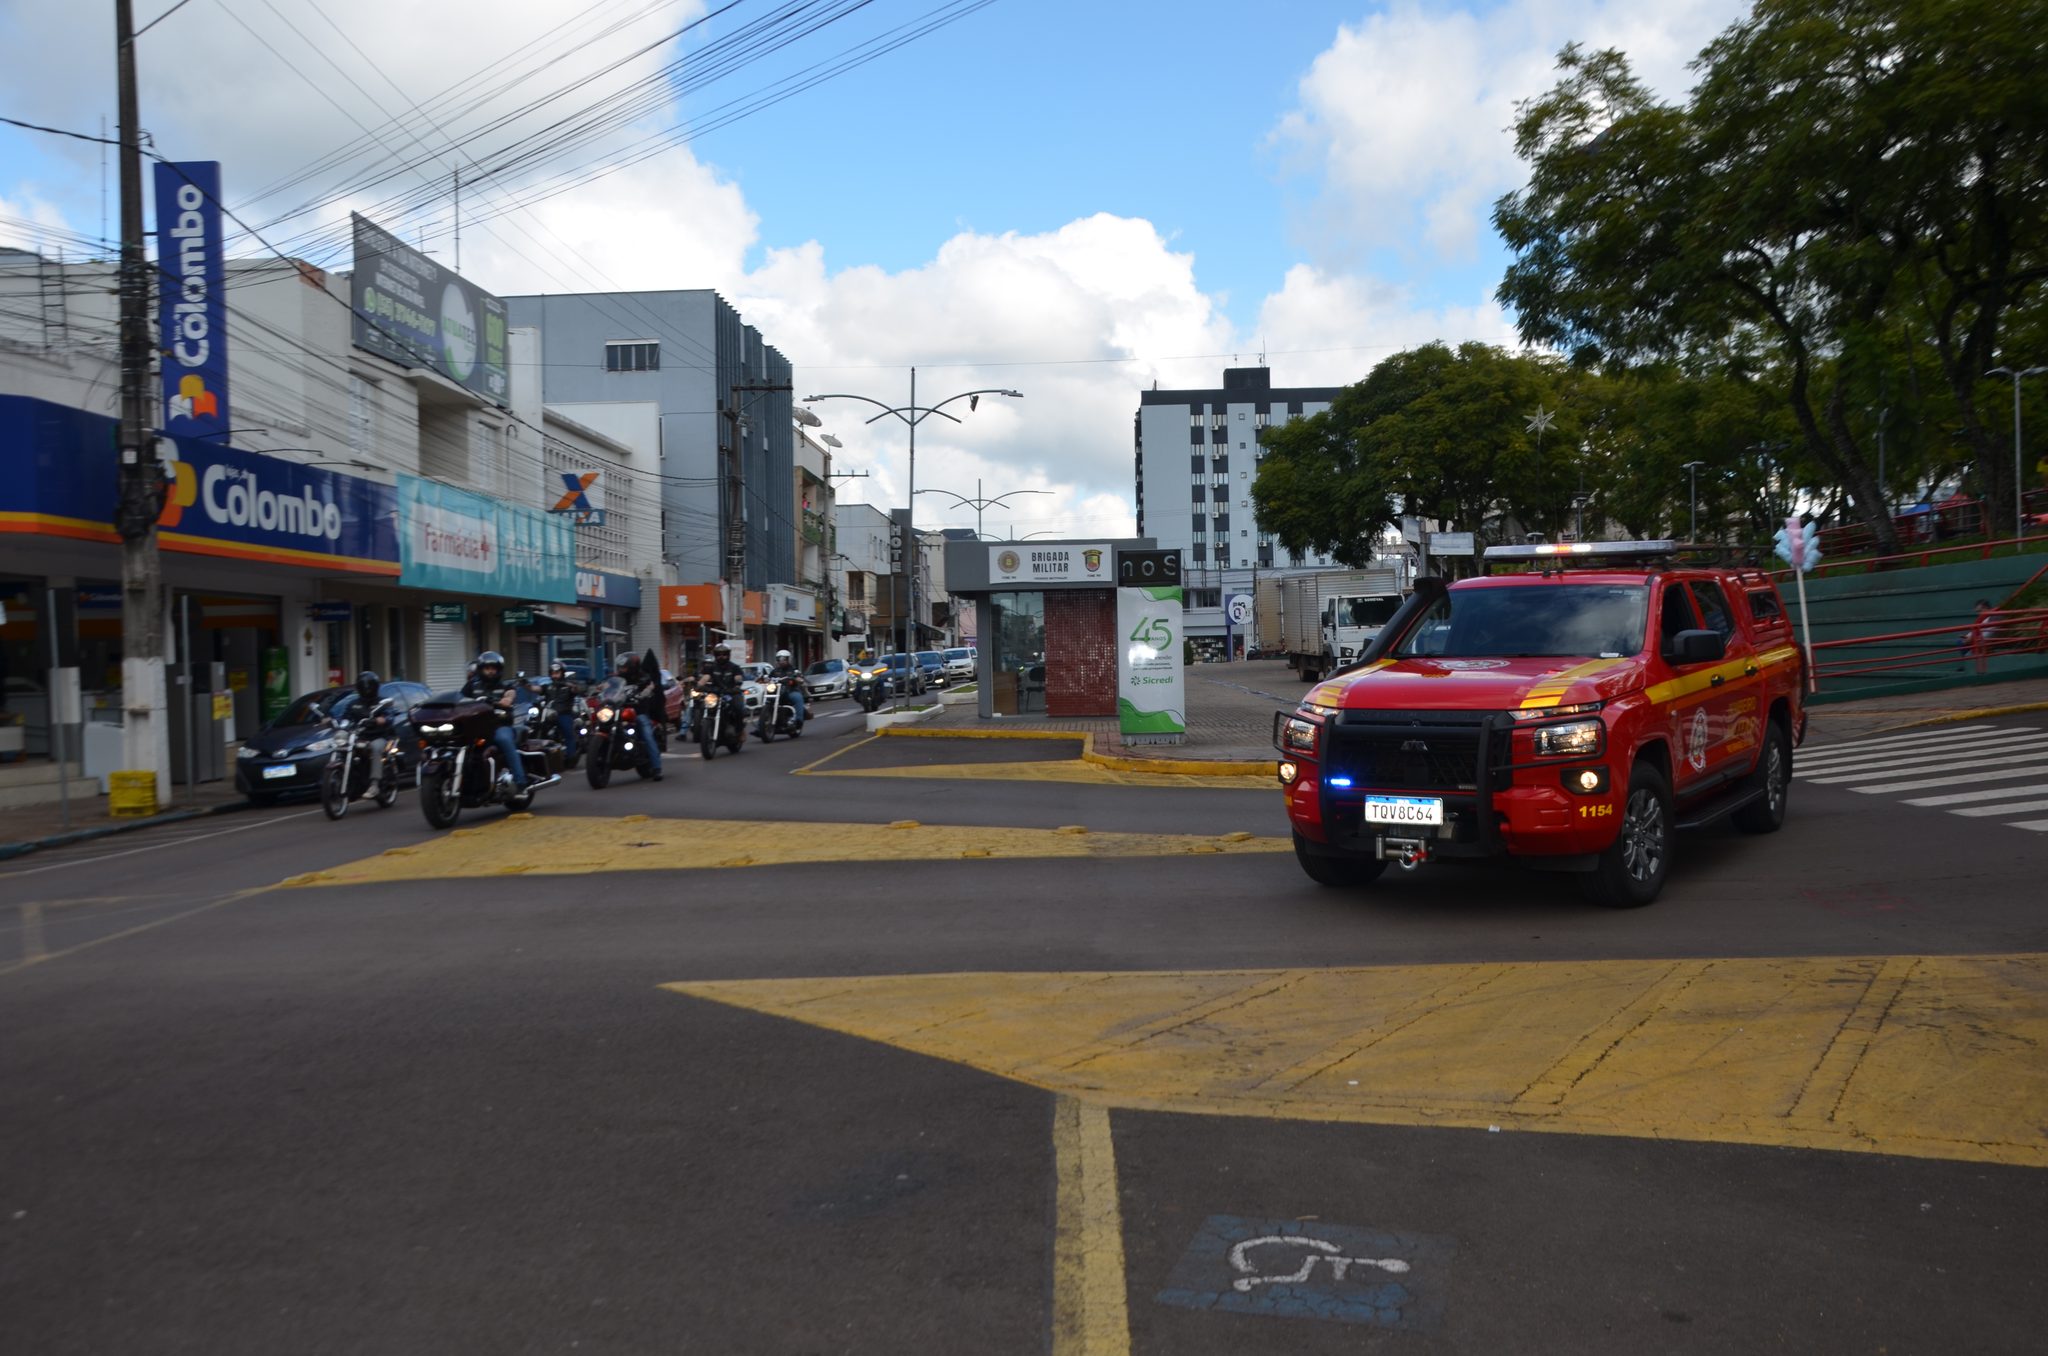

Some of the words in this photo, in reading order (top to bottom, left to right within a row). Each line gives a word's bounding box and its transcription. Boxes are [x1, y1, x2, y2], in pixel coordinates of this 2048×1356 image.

[170, 184, 209, 367] Colombo
[203, 464, 342, 540] Colombo
[1031, 551, 1069, 562] BRIGADA
[1032, 562, 1069, 573] MILITAR
[1130, 617, 1172, 651] 45
[1142, 676, 1173, 685] Sicredi
[1372, 804, 1433, 821] TQV8C64
[1579, 804, 1613, 818] 1154
